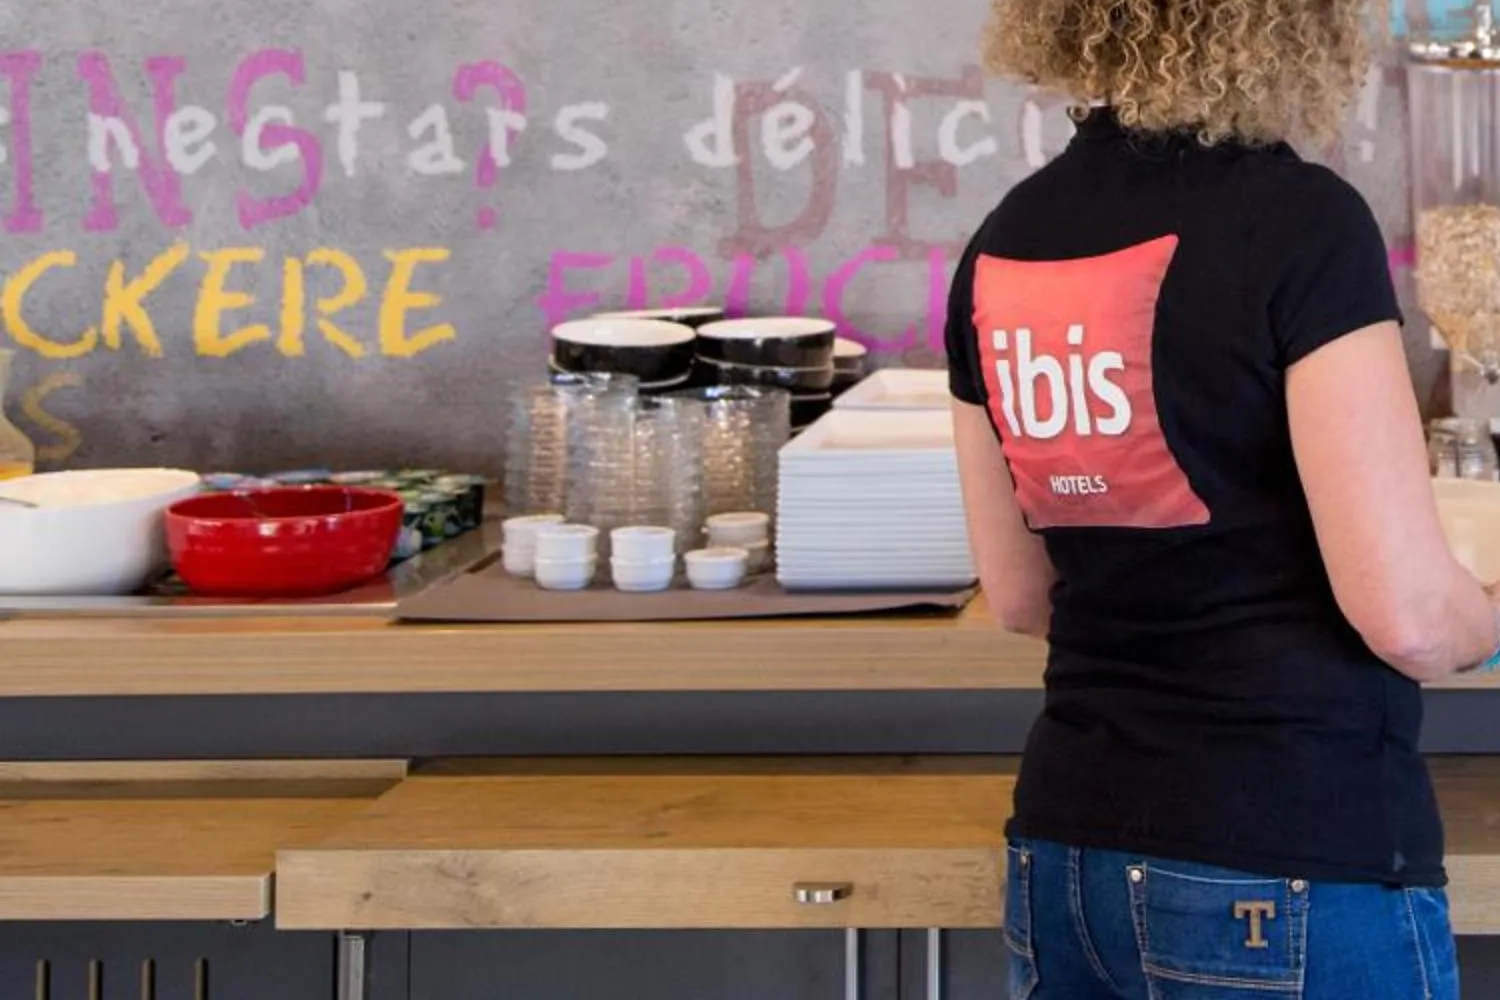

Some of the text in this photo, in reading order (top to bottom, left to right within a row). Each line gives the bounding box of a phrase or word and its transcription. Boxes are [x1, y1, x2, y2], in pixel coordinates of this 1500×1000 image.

[86, 69, 609, 176] nectars
[683, 66, 1077, 170] délici
[0, 241, 457, 359] CKERE
[992, 324, 1131, 439] ibis
[1050, 475, 1107, 495] HOTELS
[1232, 899, 1276, 950] T
